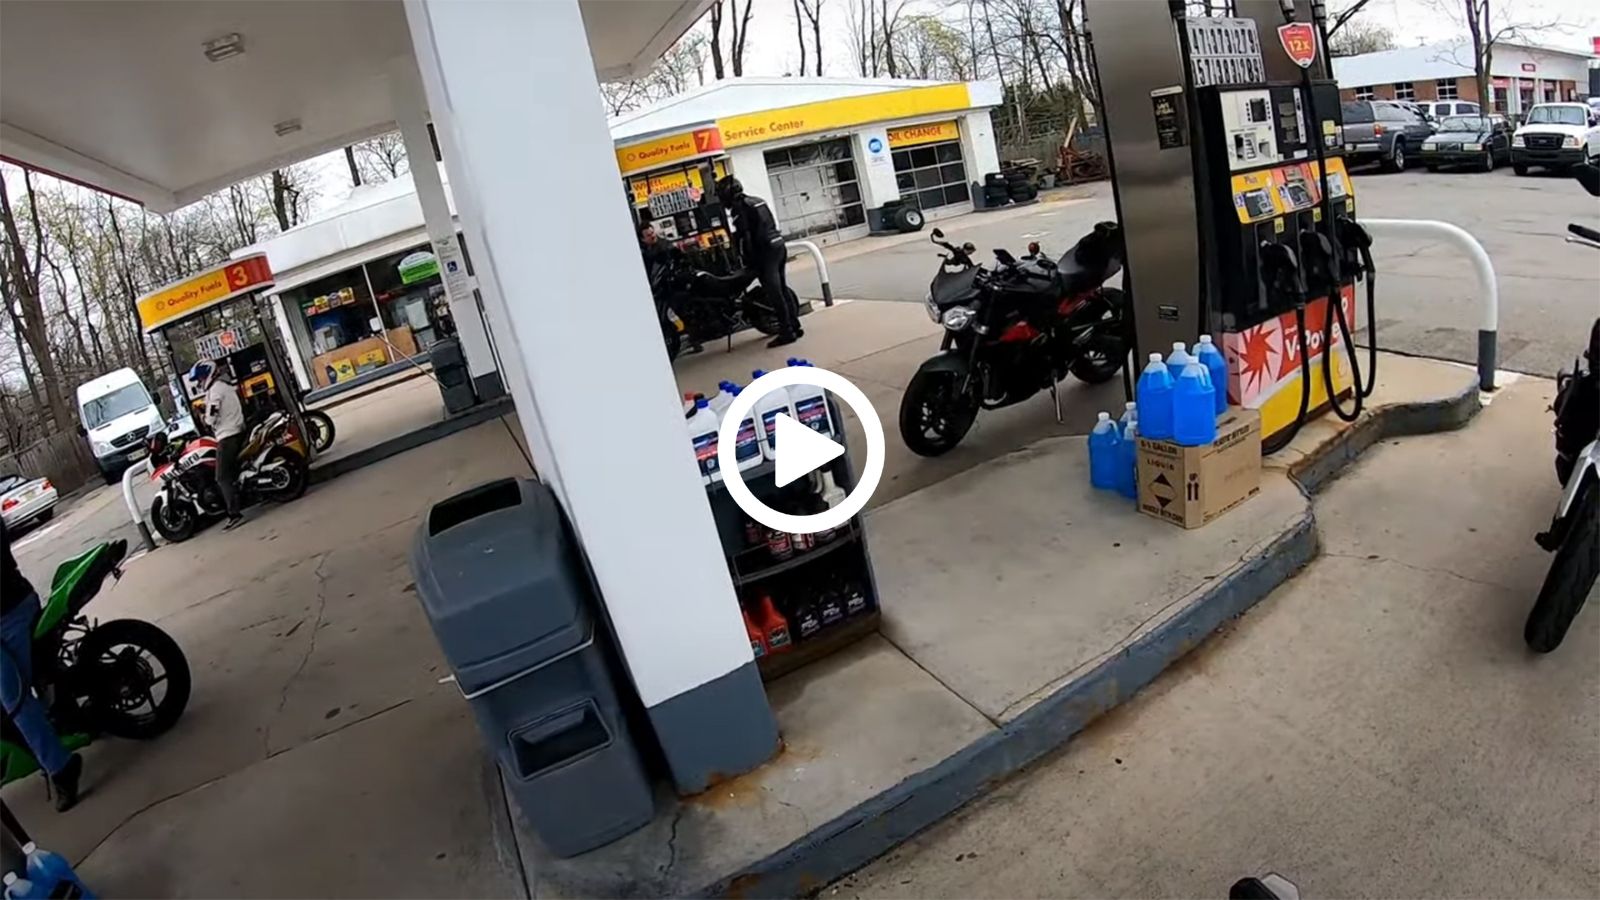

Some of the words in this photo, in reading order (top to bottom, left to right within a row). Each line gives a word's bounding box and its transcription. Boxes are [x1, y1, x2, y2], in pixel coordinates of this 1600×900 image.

[724, 127, 765, 142] Service
[769, 119, 804, 132] Center
[904, 127, 942, 139] CHANGE
[639, 146, 669, 159] Quality
[670, 141, 691, 153] Fuels
[697, 132, 711, 150] 7
[168, 290, 200, 306] Quality
[200, 281, 222, 294] Fuels
[232, 266, 248, 286] 3
